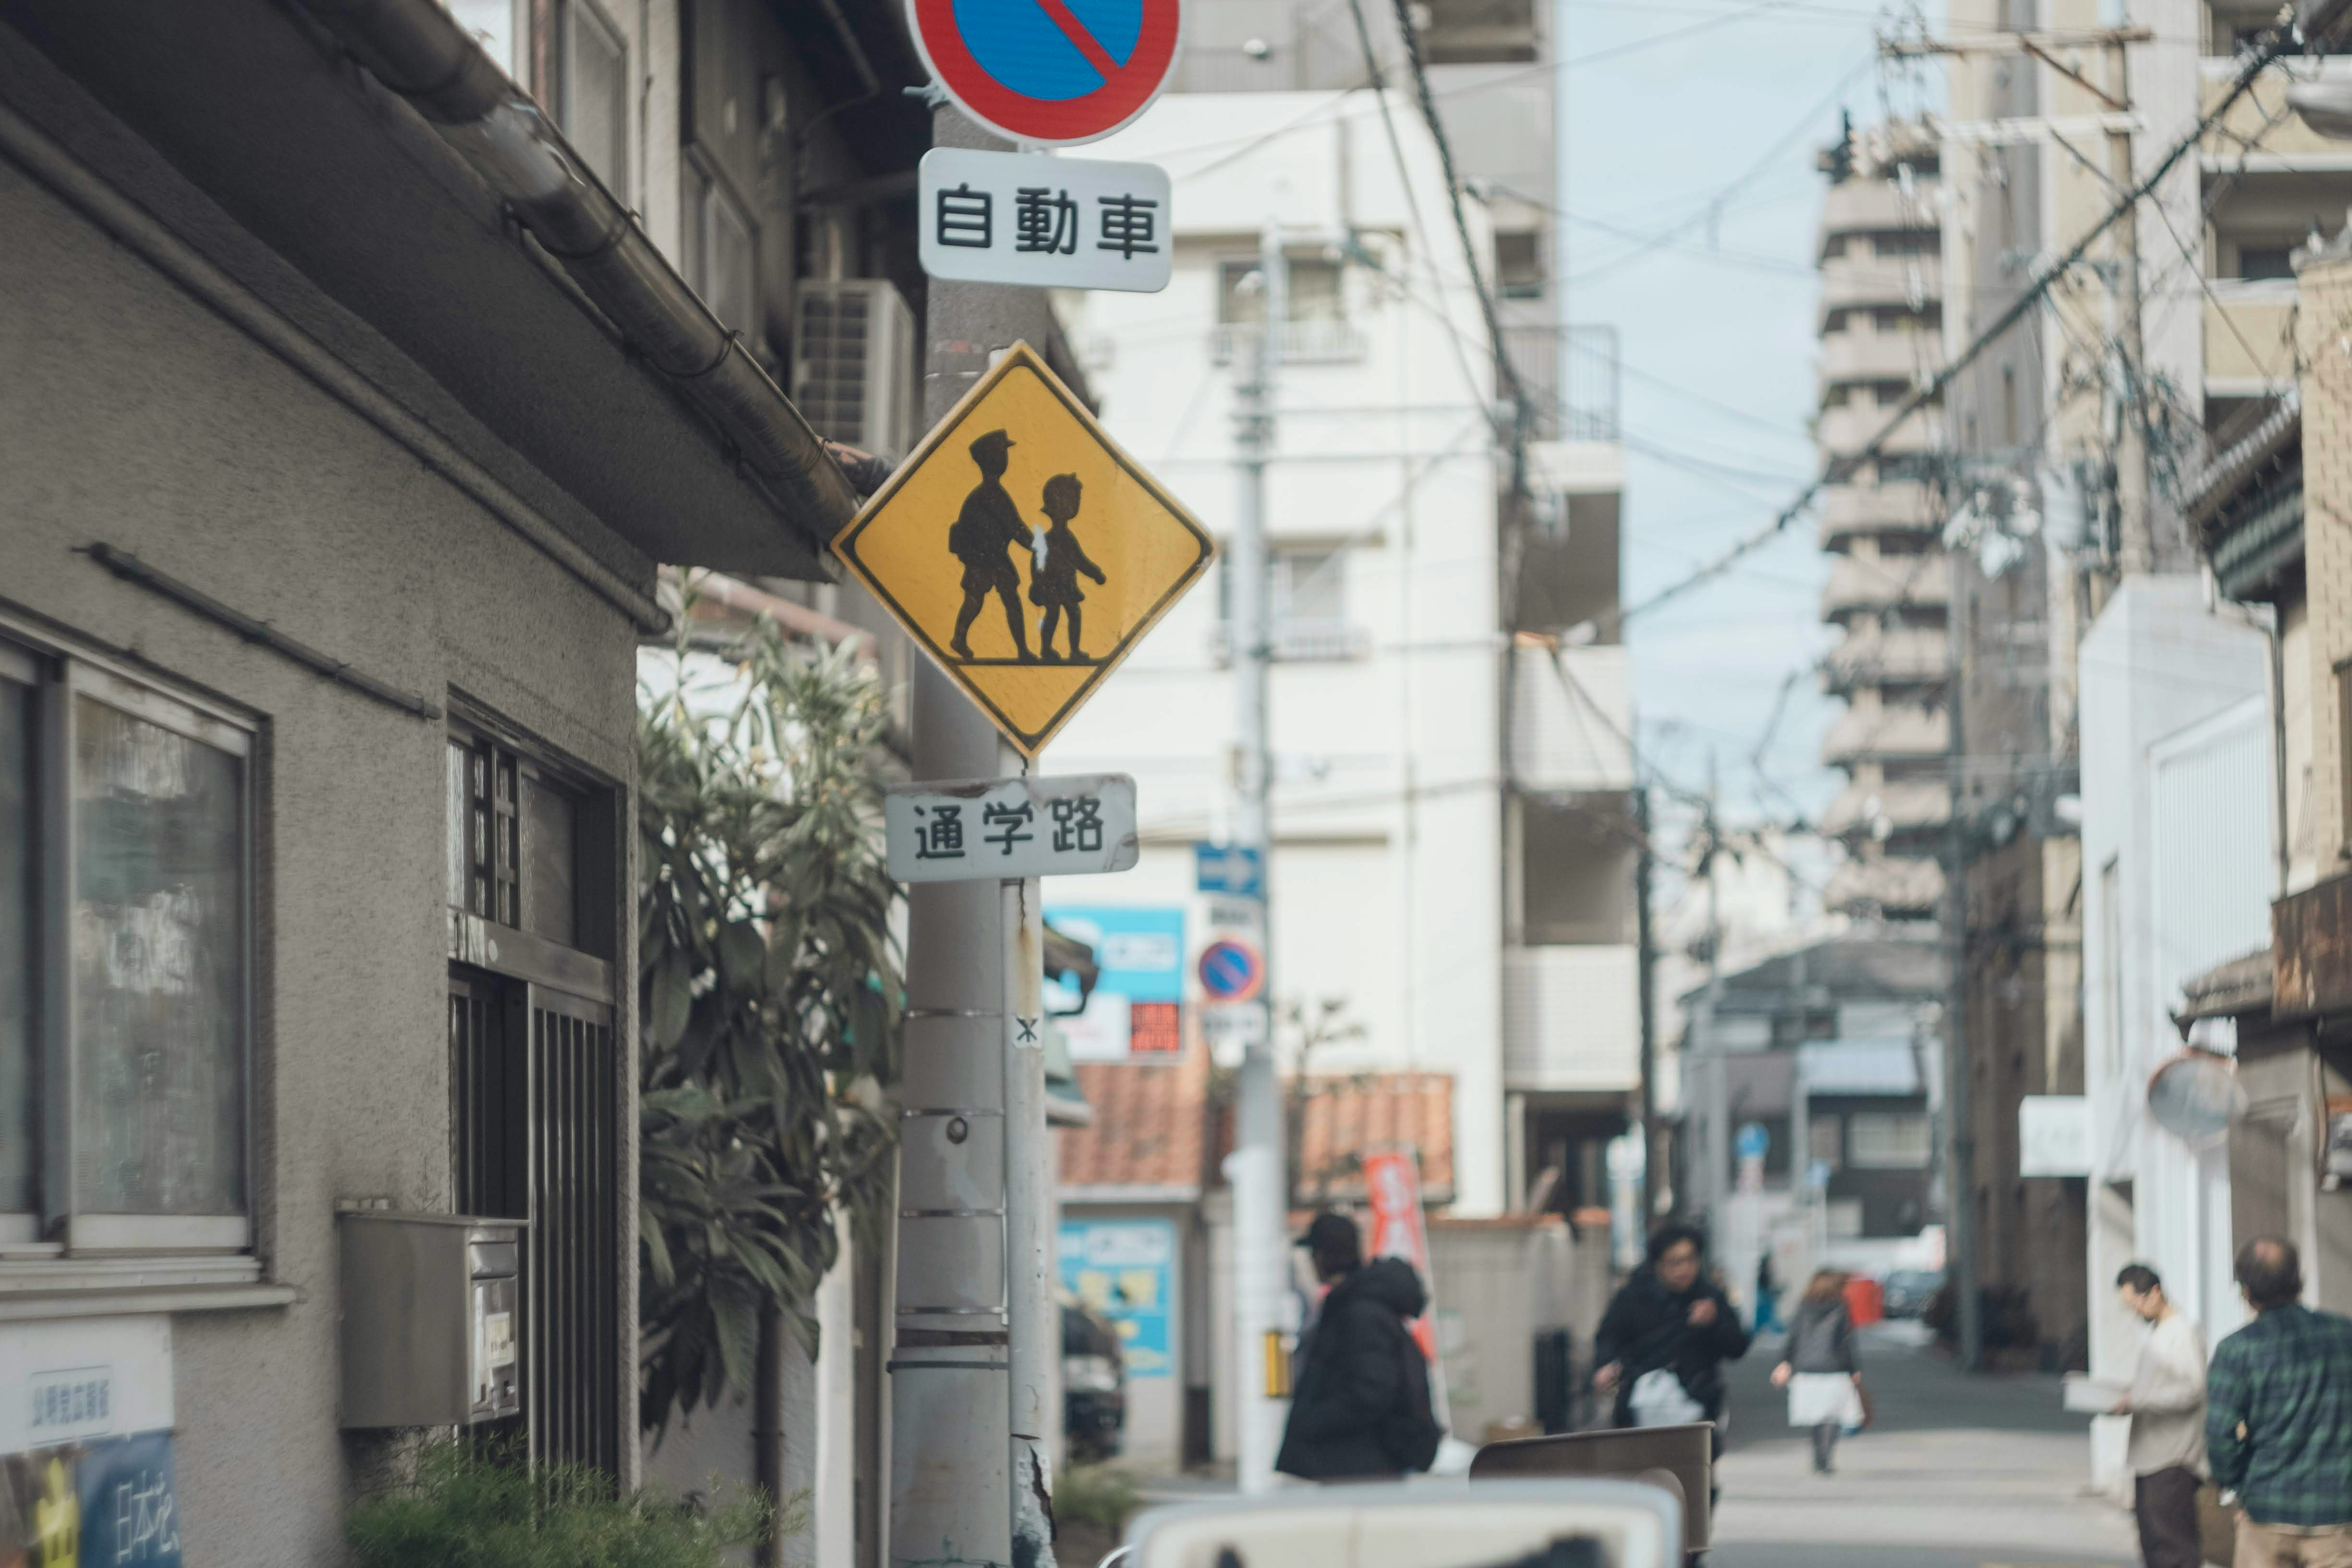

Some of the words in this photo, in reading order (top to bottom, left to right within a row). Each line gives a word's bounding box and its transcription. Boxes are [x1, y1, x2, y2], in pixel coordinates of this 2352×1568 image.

[937, 182, 1159, 260] 自動車
[914, 798, 1103, 859] 通学路
